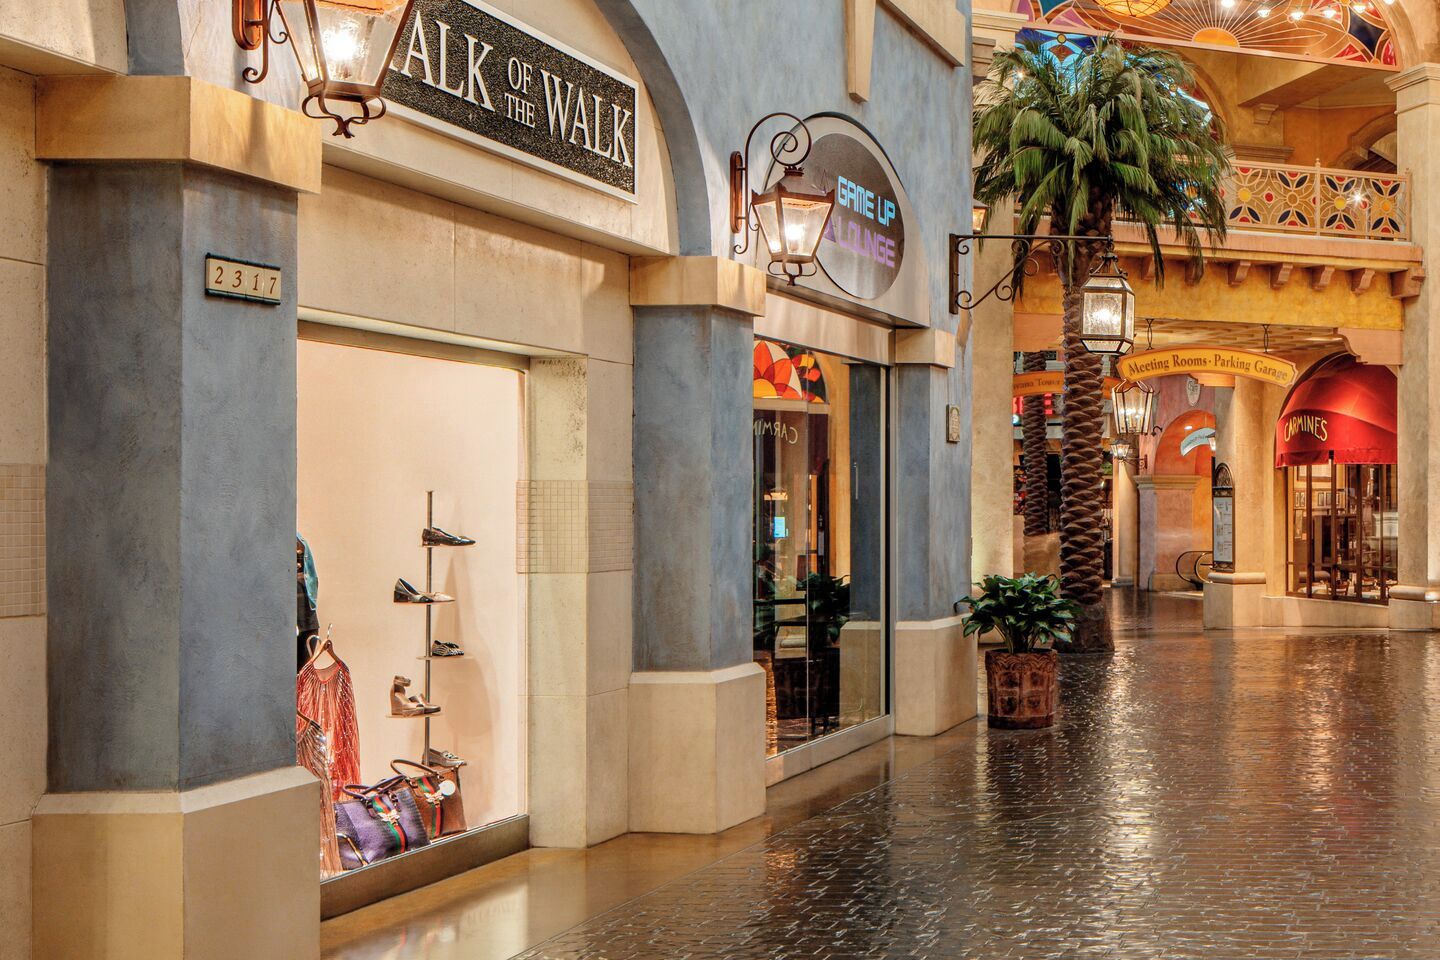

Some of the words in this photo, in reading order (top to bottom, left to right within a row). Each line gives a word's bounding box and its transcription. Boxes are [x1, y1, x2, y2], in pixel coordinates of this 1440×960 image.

[389, 10, 496, 112] ALK
[508, 57, 533, 94] OF
[504, 92, 535, 128] THE
[540, 68, 633, 168] WALK
[837, 175, 875, 220] GAME
[878, 196, 896, 227] UP
[838, 216, 895, 268] LOUNGE
[214, 266, 277, 294] 2317
[1035, 378, 1060, 387] Tower
[1128, 358, 1170, 376] Meeting
[1172, 354, 1207, 368] Rooms
[1214, 353, 1251, 372] Parking
[1254, 360, 1288, 381] Garage
[1284, 414, 1328, 442] CARMINE'S
